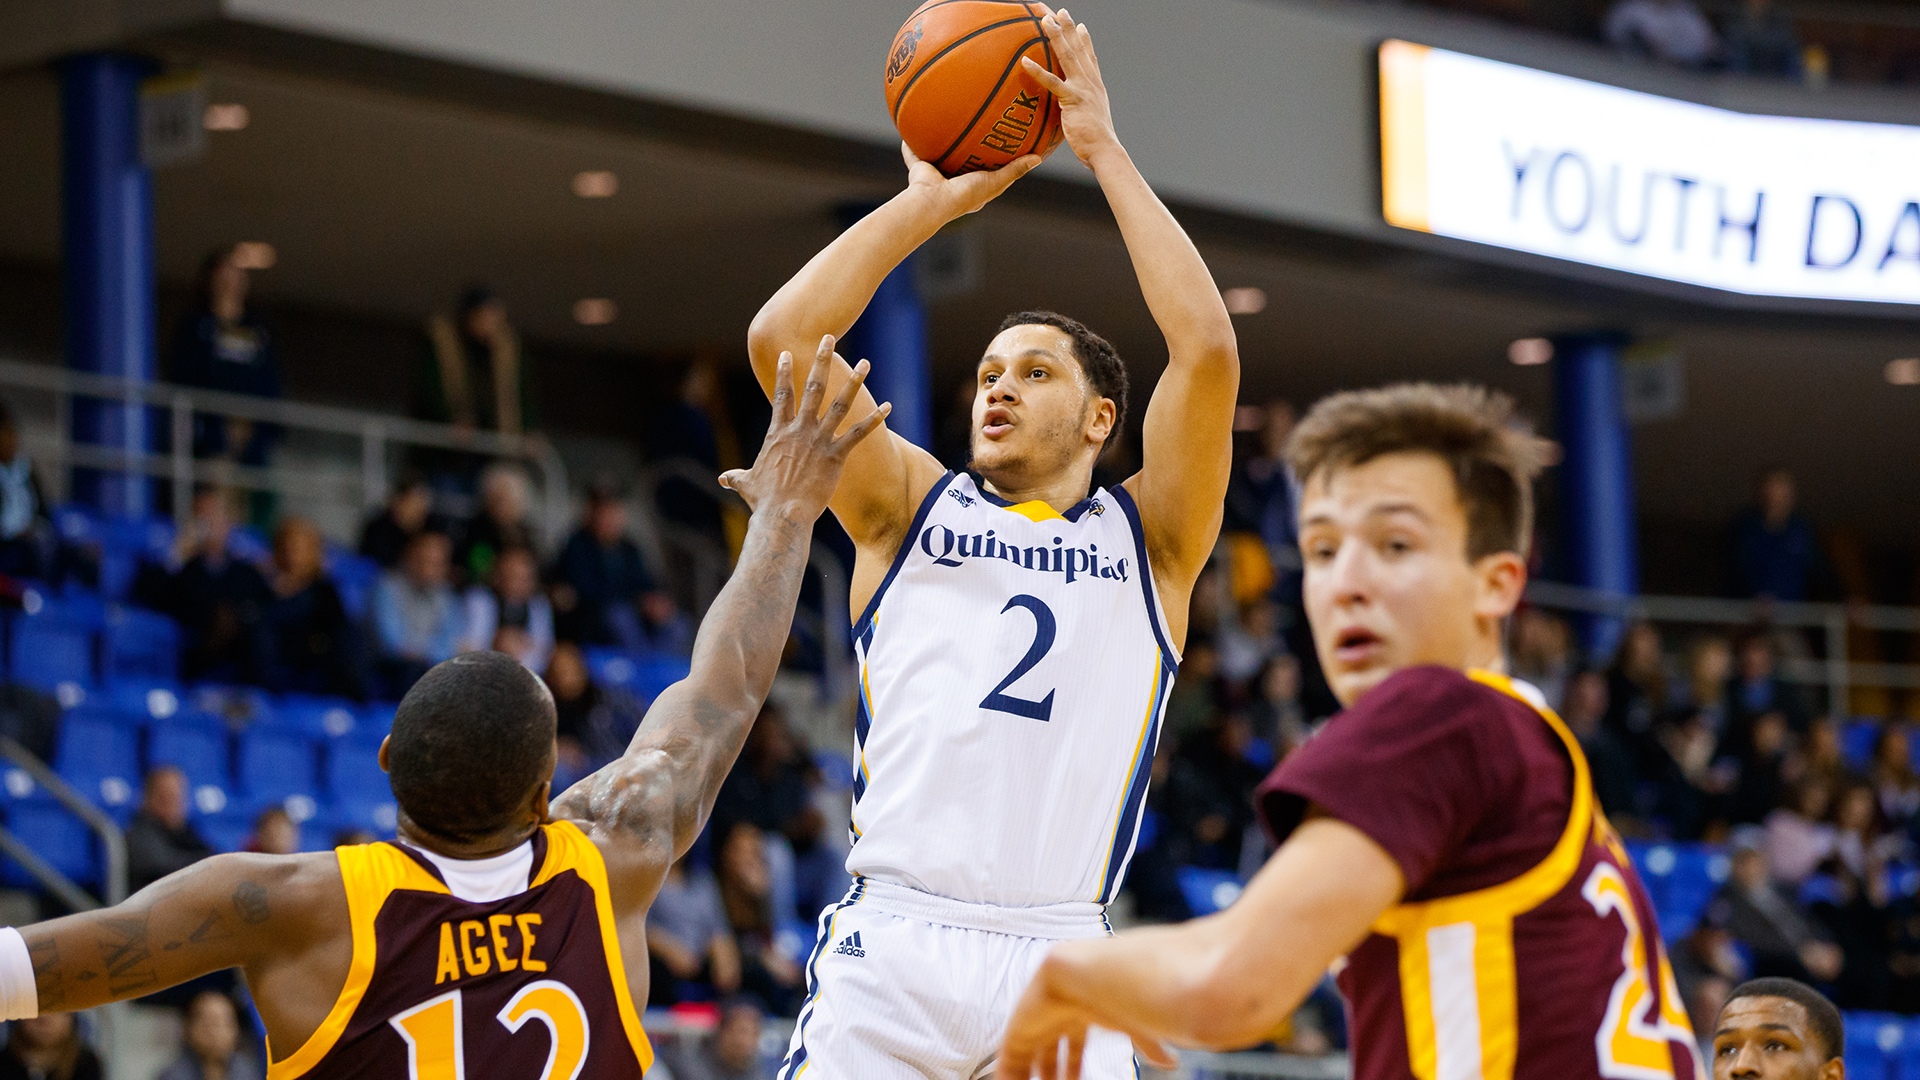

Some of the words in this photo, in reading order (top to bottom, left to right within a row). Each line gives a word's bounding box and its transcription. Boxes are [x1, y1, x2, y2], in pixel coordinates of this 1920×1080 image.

[979, 88, 1040, 156] ROCK
[1502, 140, 1765, 265] YOUTH
[1804, 194, 1920, 272] DA
[979, 594, 1057, 722] 2
[435, 912, 548, 985] AGEE
[388, 979, 590, 1080] 12
